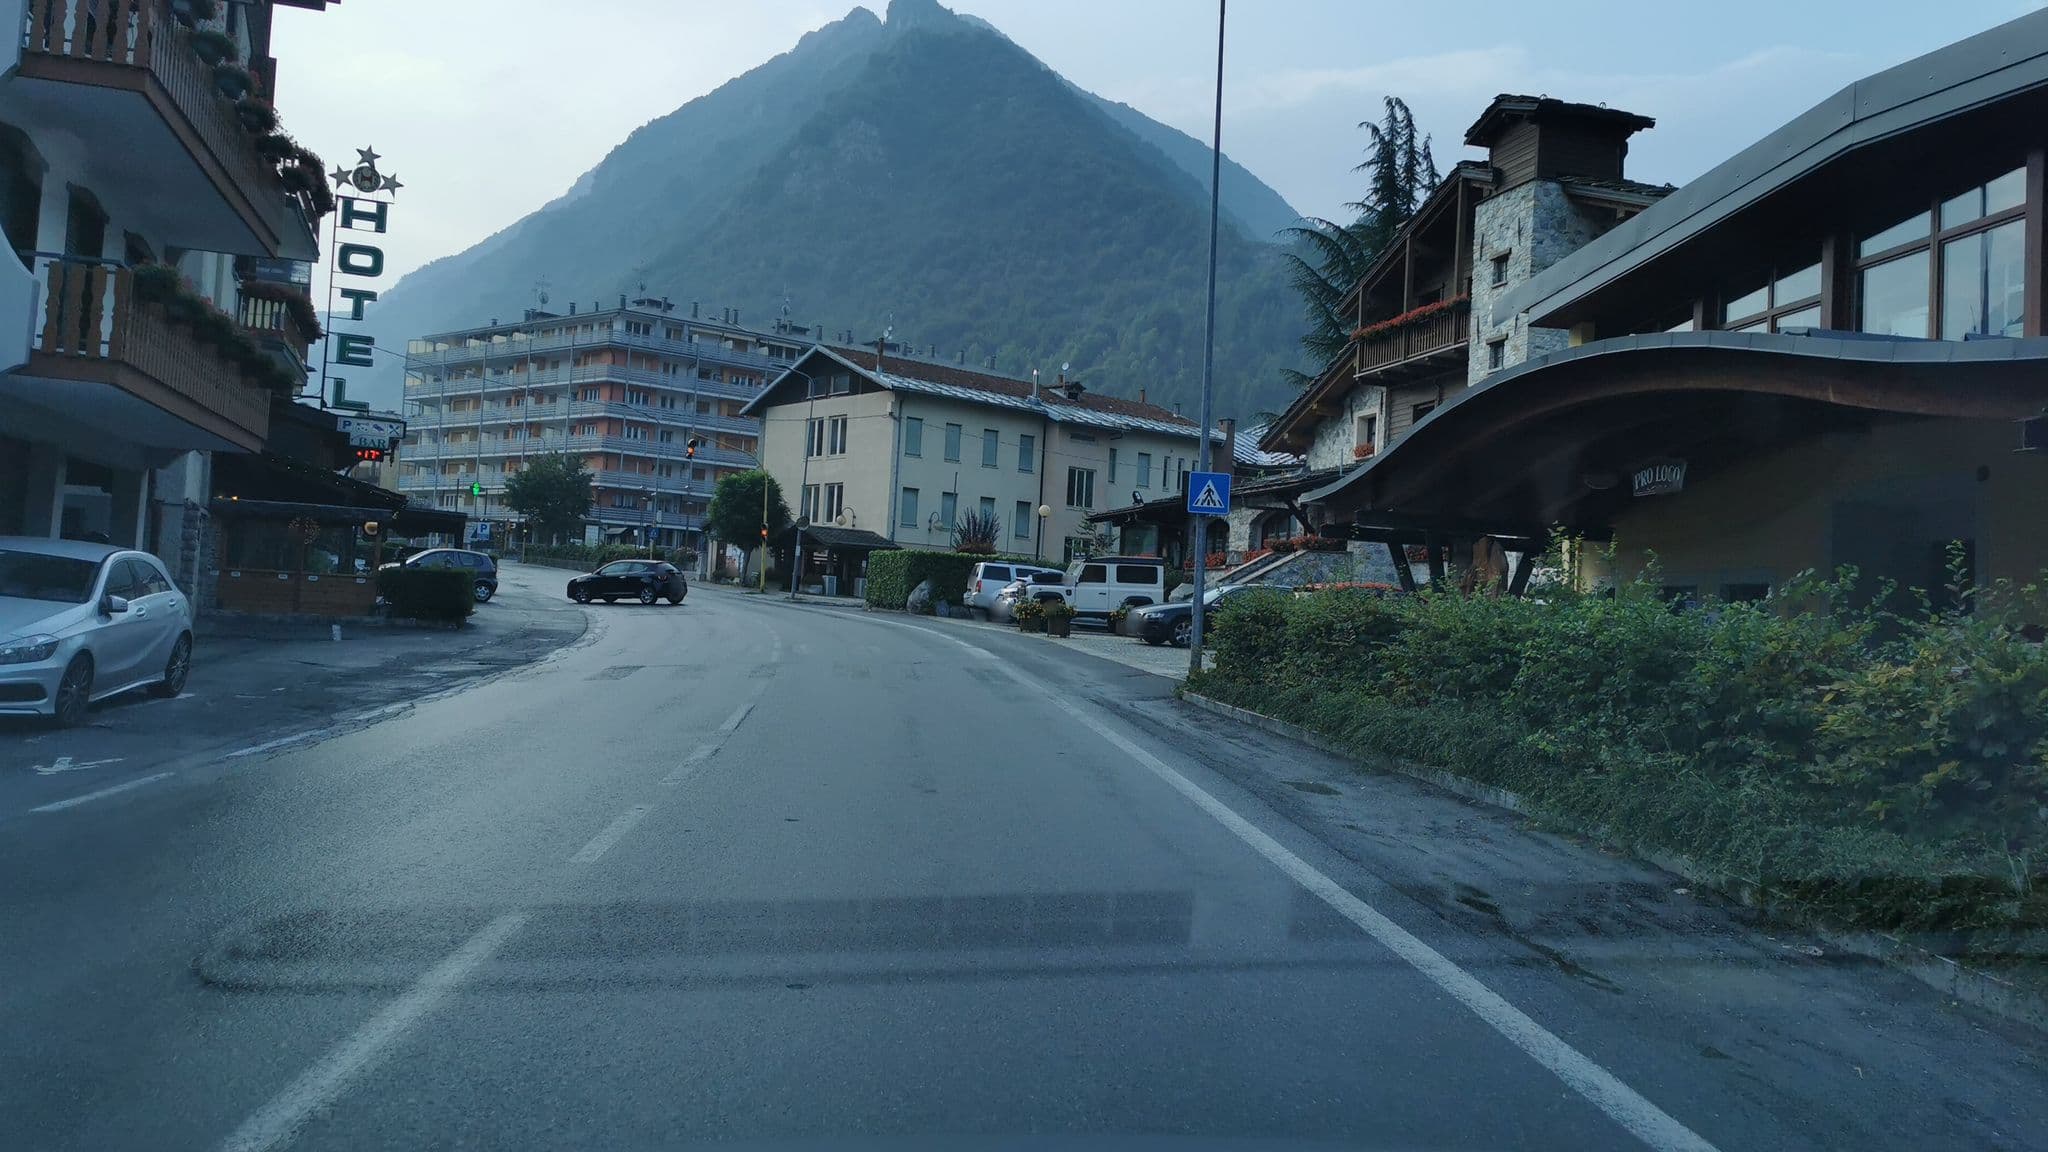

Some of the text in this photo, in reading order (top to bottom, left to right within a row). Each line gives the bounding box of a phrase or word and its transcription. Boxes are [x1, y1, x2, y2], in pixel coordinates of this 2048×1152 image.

[332, 197, 388, 411] HOTEL
[359, 436, 386, 449] BAR
[1634, 467, 1653, 490] PRO
[1655, 464, 1681, 482] LOCO
[480, 523, 488, 533] P
